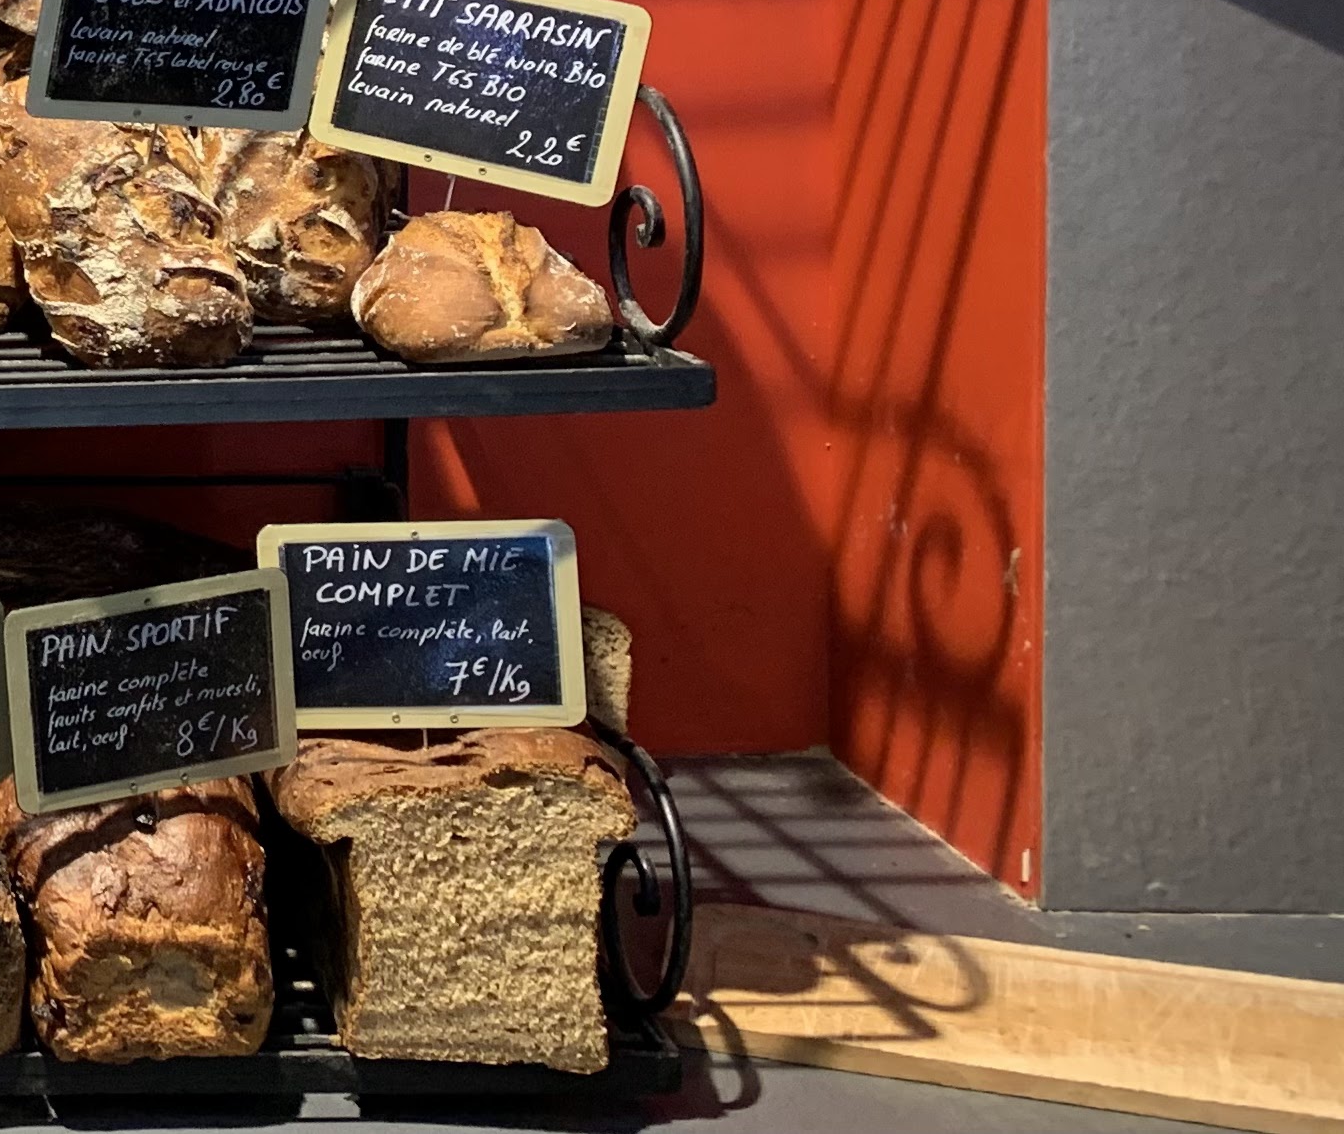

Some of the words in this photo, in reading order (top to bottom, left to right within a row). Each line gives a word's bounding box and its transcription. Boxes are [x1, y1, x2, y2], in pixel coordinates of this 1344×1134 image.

[70, 16, 134, 41] levain
[141, 28, 218, 48] naturel
[456, 2, 612, 51] SARRASIN
[64, 46, 128, 68] farine
[134, 48, 172, 68] T65
[170, 50, 215, 70] label
[214, 59, 268, 81] rouge
[364, 14, 429, 48] farine
[437, 36, 464, 55] de
[467, 42, 502, 65] blé
[564, 60, 607, 89] BIO
[355, 45, 421, 76] farine
[431, 60, 474, 90] T65
[481, 75, 527, 103] BIO
[347, 70, 414, 106] levain
[424, 97, 520, 128] naturel
[302, 544, 392, 573] PAIN
[406, 548, 450, 574] DE
[463, 544, 524, 573] MIE
[315, 581, 470, 607] COMPLET
[41, 628, 111, 667] PAIN
[125, 606, 240, 652] SPORTIF
[300, 617, 365, 648] farine
[48, 679, 109, 712] farine
[48, 708, 96, 737] fruits
[107, 695, 166, 723] confits
[174, 692, 194, 707] et
